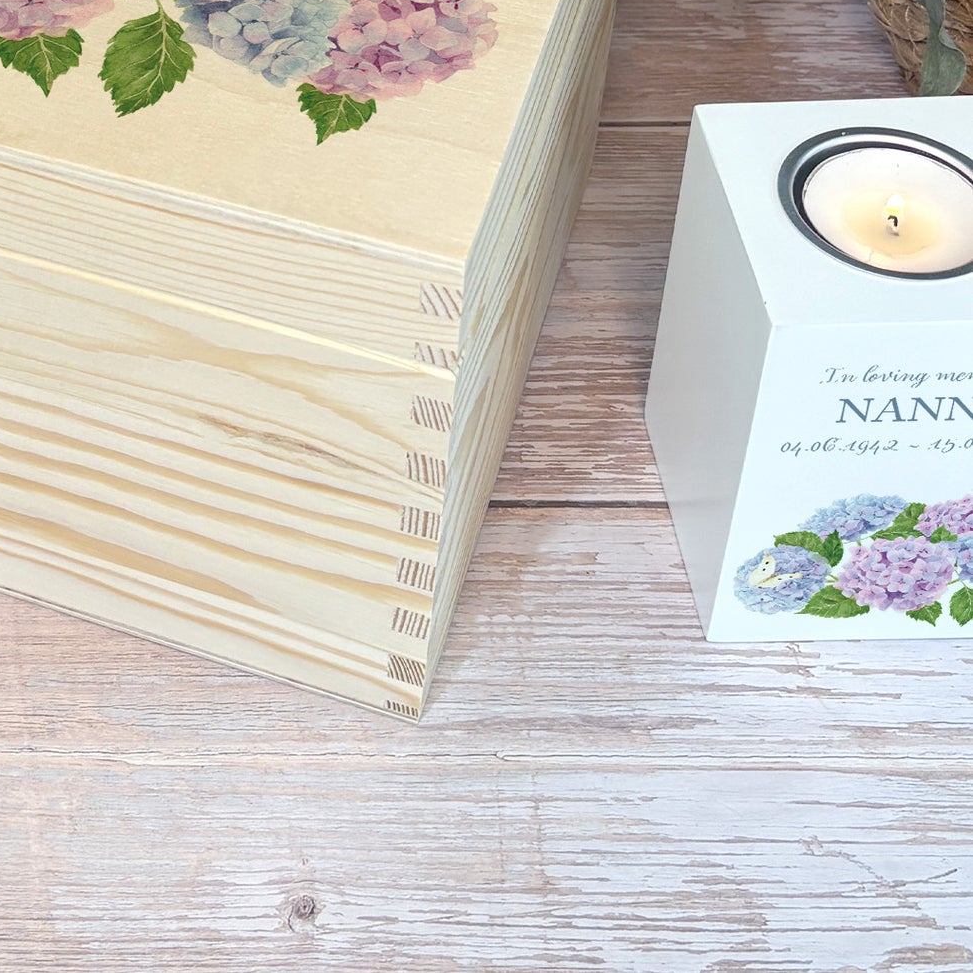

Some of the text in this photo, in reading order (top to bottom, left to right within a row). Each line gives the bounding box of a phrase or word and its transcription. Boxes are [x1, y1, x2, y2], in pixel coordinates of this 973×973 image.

[819, 367, 858, 385] In
[862, 364, 930, 388] loving
[835, 396, 973, 424] NANN
[780, 437, 899, 457] 04.06.1942
